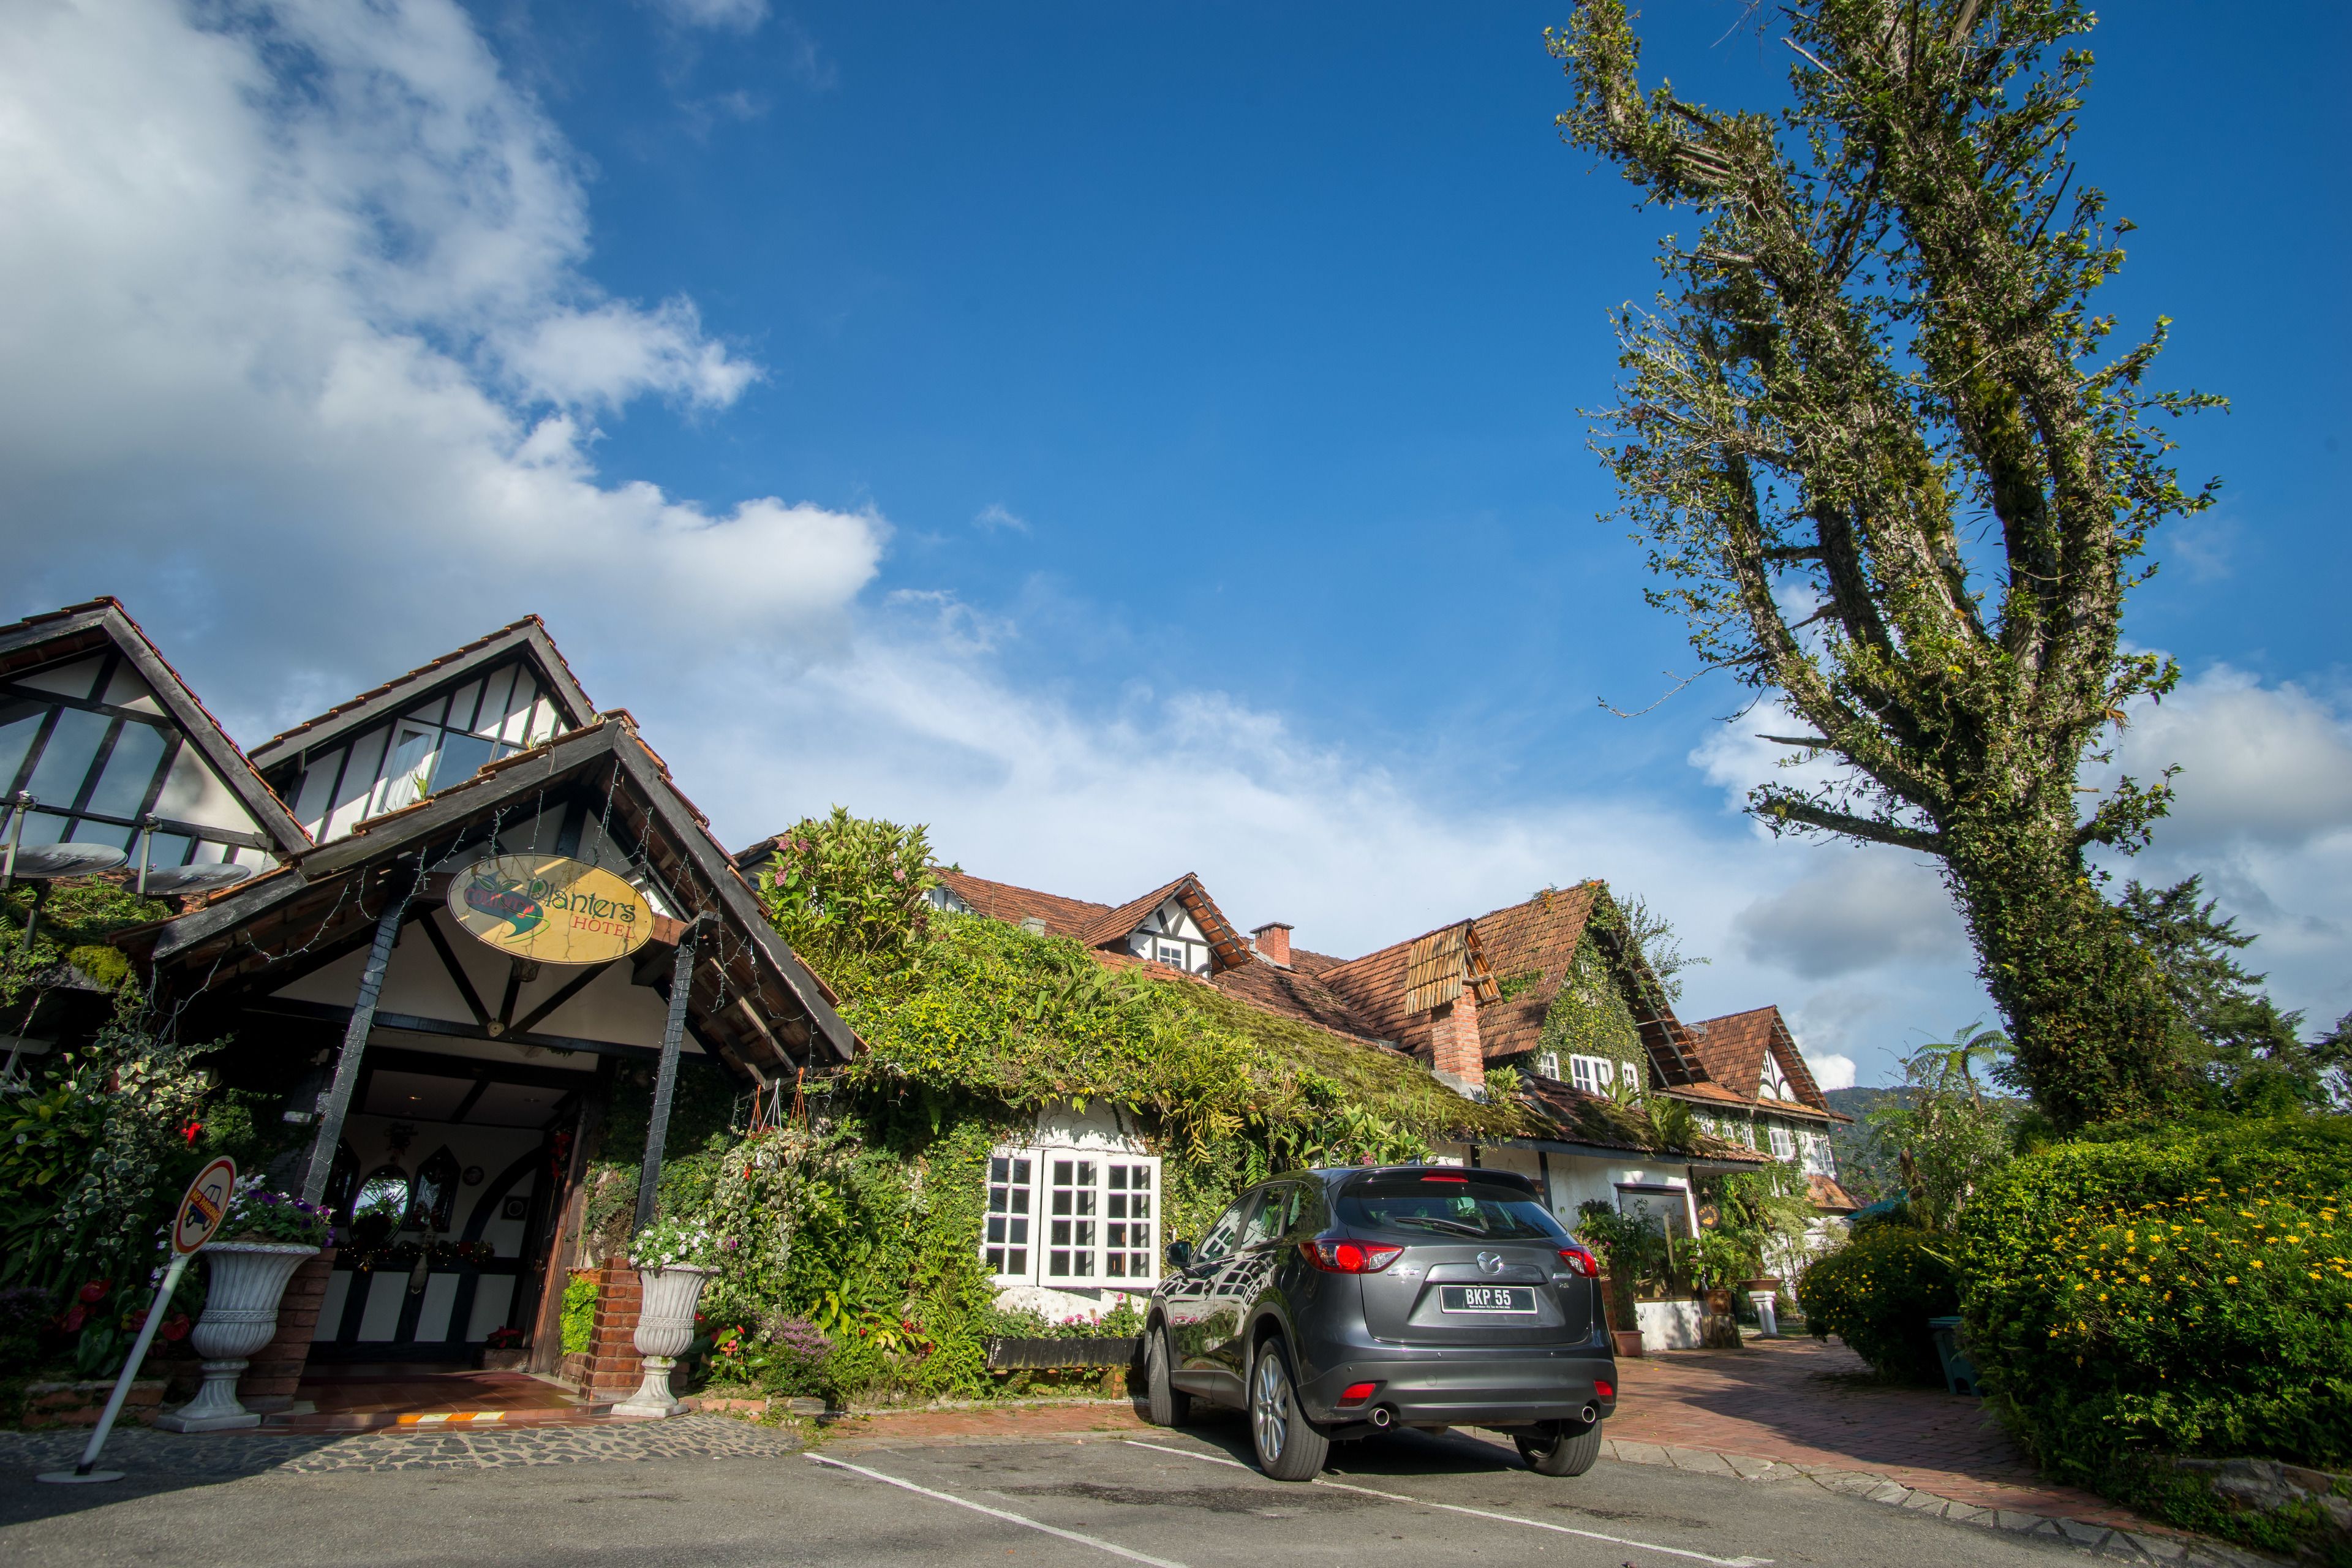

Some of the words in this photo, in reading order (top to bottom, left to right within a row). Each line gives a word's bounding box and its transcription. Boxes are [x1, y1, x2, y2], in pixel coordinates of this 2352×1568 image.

[527, 878, 636, 922] Planters
[572, 916, 635, 939] HOTEL
[190, 1190, 202, 1201] NO
[199, 1197, 221, 1223] PARKING
[1465, 1289, 1491, 1305] BKP
[1494, 1290, 1511, 1305] 55
